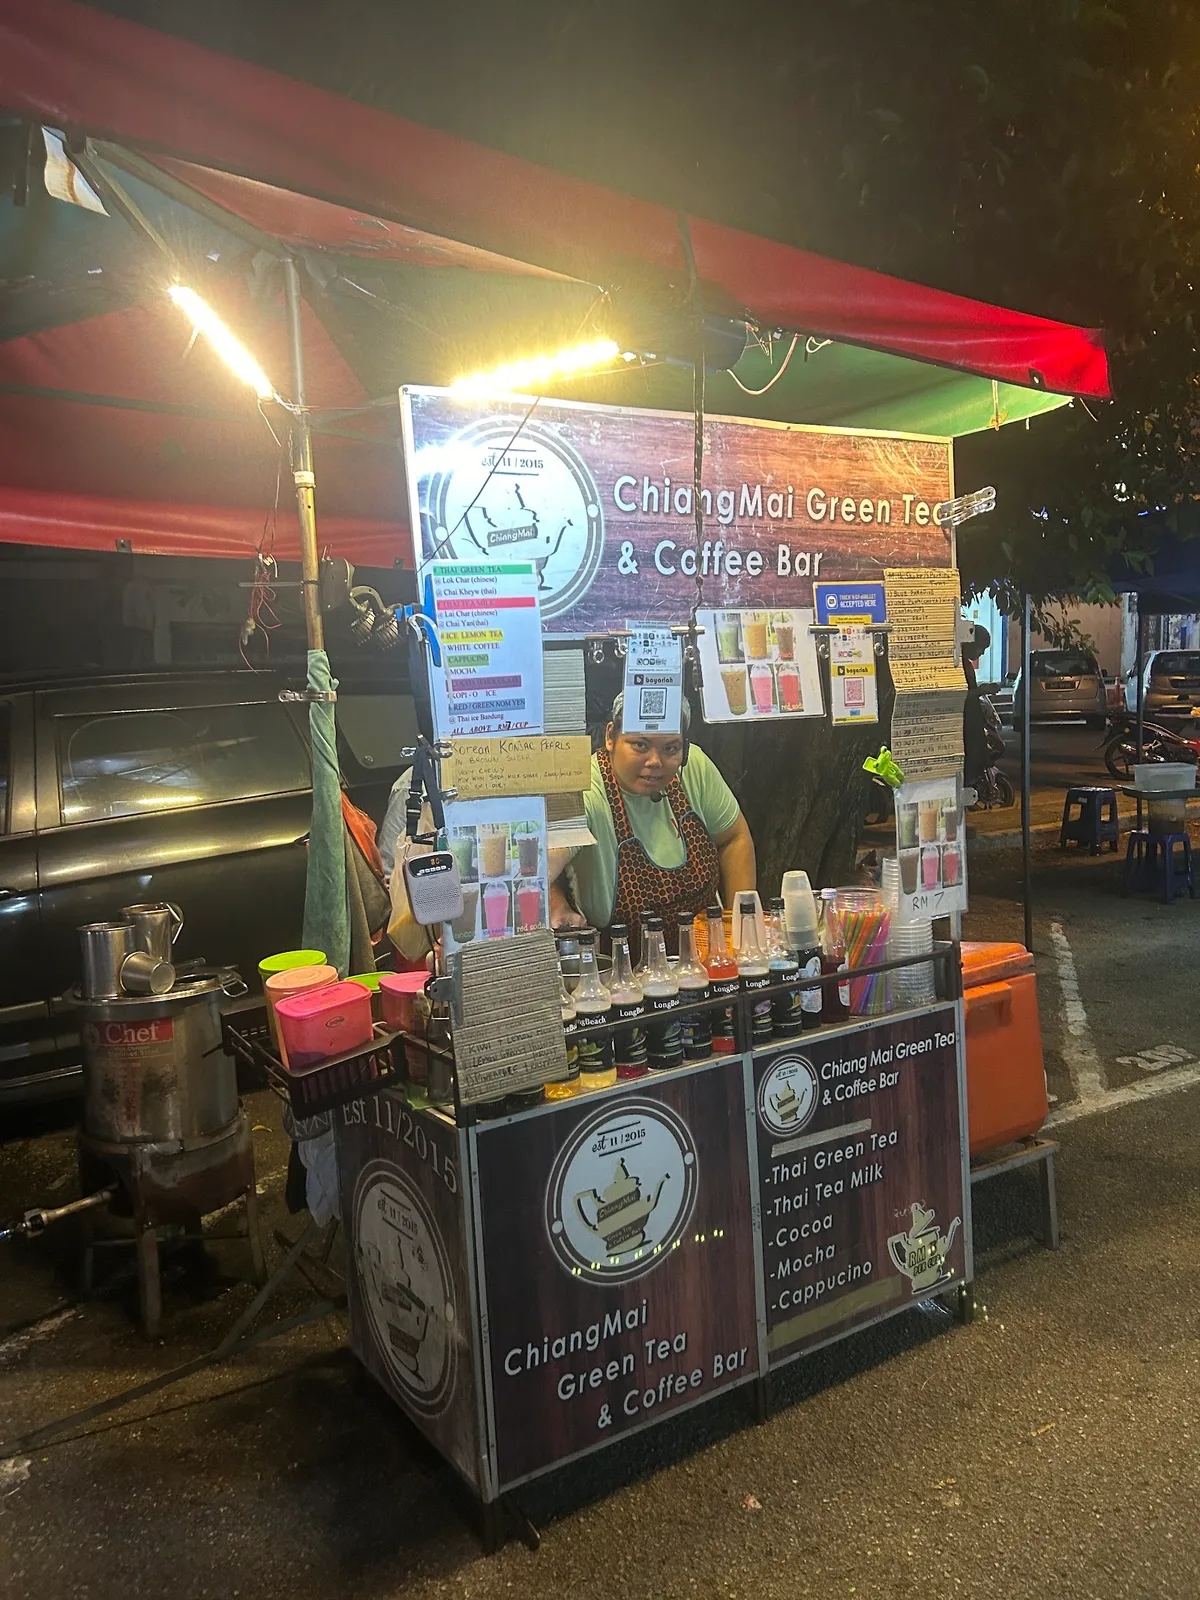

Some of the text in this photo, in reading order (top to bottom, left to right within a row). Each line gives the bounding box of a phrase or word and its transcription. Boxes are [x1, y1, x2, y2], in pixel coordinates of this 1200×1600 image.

[520, 459, 544, 469] 2015
[613, 475, 795, 525] ChiangMai
[806, 488, 892, 525] Green
[490, 528, 534, 544] ChiangMai
[618, 540, 824, 577] & Coffee Bar
[460, 566, 485, 574] GREEN
[456, 576, 470, 584] Char
[471, 576, 498, 584] (chinese)
[481, 588, 497, 596] (thai)
[476, 599, 495, 607] MILK
[840, 599, 877, 608] ACCEPTED HERE
[444, 610, 455, 618] Lai
[471, 609, 498, 618] (chinese)
[446, 620, 460, 628] Chai
[446, 632, 459, 640] ICE
[461, 631, 487, 639] LEMON
[490, 630, 503, 638] TEA
[447, 643, 500, 652] WHITE COFFEE
[448, 655, 489, 664] CAPPUCINO
[454, 703, 468, 711] RED
[472, 701, 495, 710] GREEN
[496, 700, 511, 708] NOM
[457, 715, 470, 723] Thai
[480, 713, 504, 721] Bandung
[469, 724, 492, 733] ABOVE
[912, 892, 944, 911] RM 7
[517, 923, 528, 933] red
[105, 1021, 159, 1044] Chef
[821, 1031, 955, 1081] Chiang Mai Green Tea
[822, 1069, 900, 1106] & Coffee Bar
[592, 1135, 609, 1153] est
[625, 1128, 646, 1143] 2015
[814, 1139, 864, 1171] Green
[870, 1128, 898, 1151] Tea
[815, 1177, 844, 1203] Tea
[851, 1163, 884, 1189] Milk
[599, 1194, 636, 1218] ChiangMai
[504, 1298, 649, 1377] ChiangMai
[557, 1332, 687, 1401] Green Tea
[597, 1347, 748, 1429] & Coffee Bar
